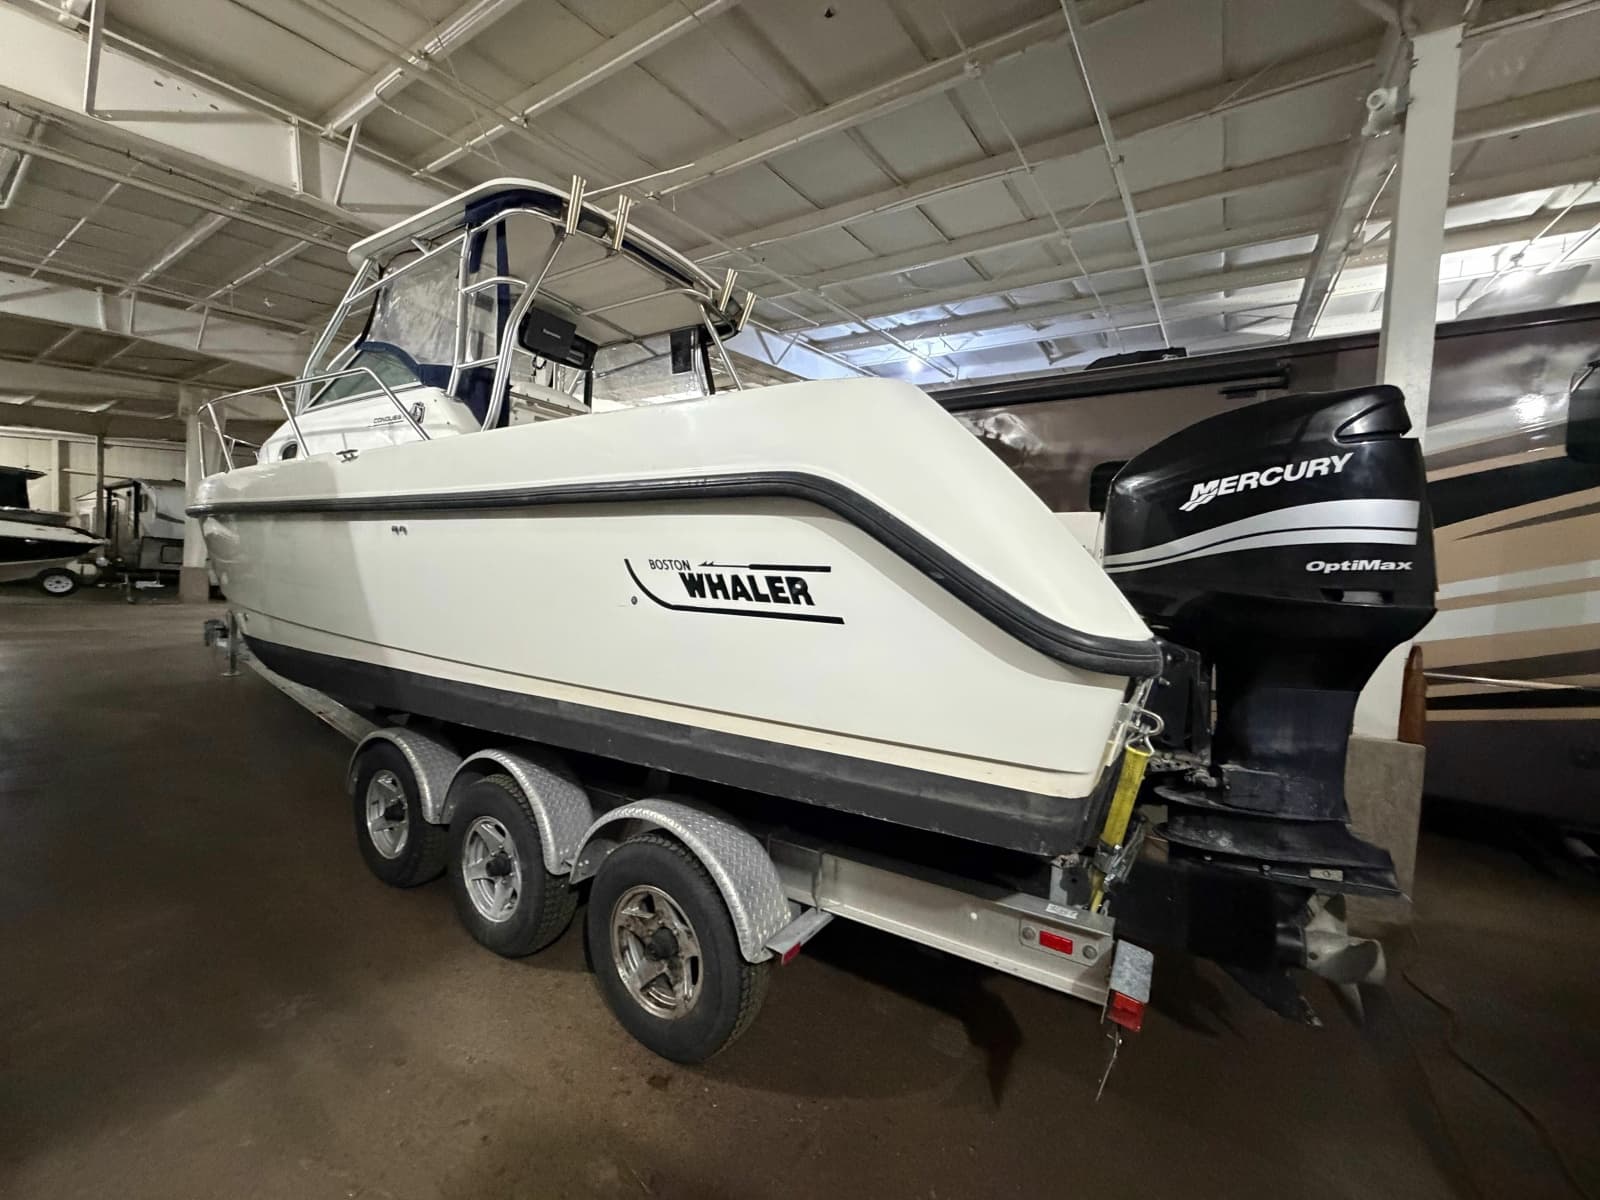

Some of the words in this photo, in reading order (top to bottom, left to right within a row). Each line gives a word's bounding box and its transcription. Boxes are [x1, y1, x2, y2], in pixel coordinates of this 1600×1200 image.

[1179, 453, 1354, 512] MERCURY
[649, 559, 692, 571] BOSTON
[1306, 559, 1413, 574] OptiMax
[679, 572, 815, 606] WHALER
